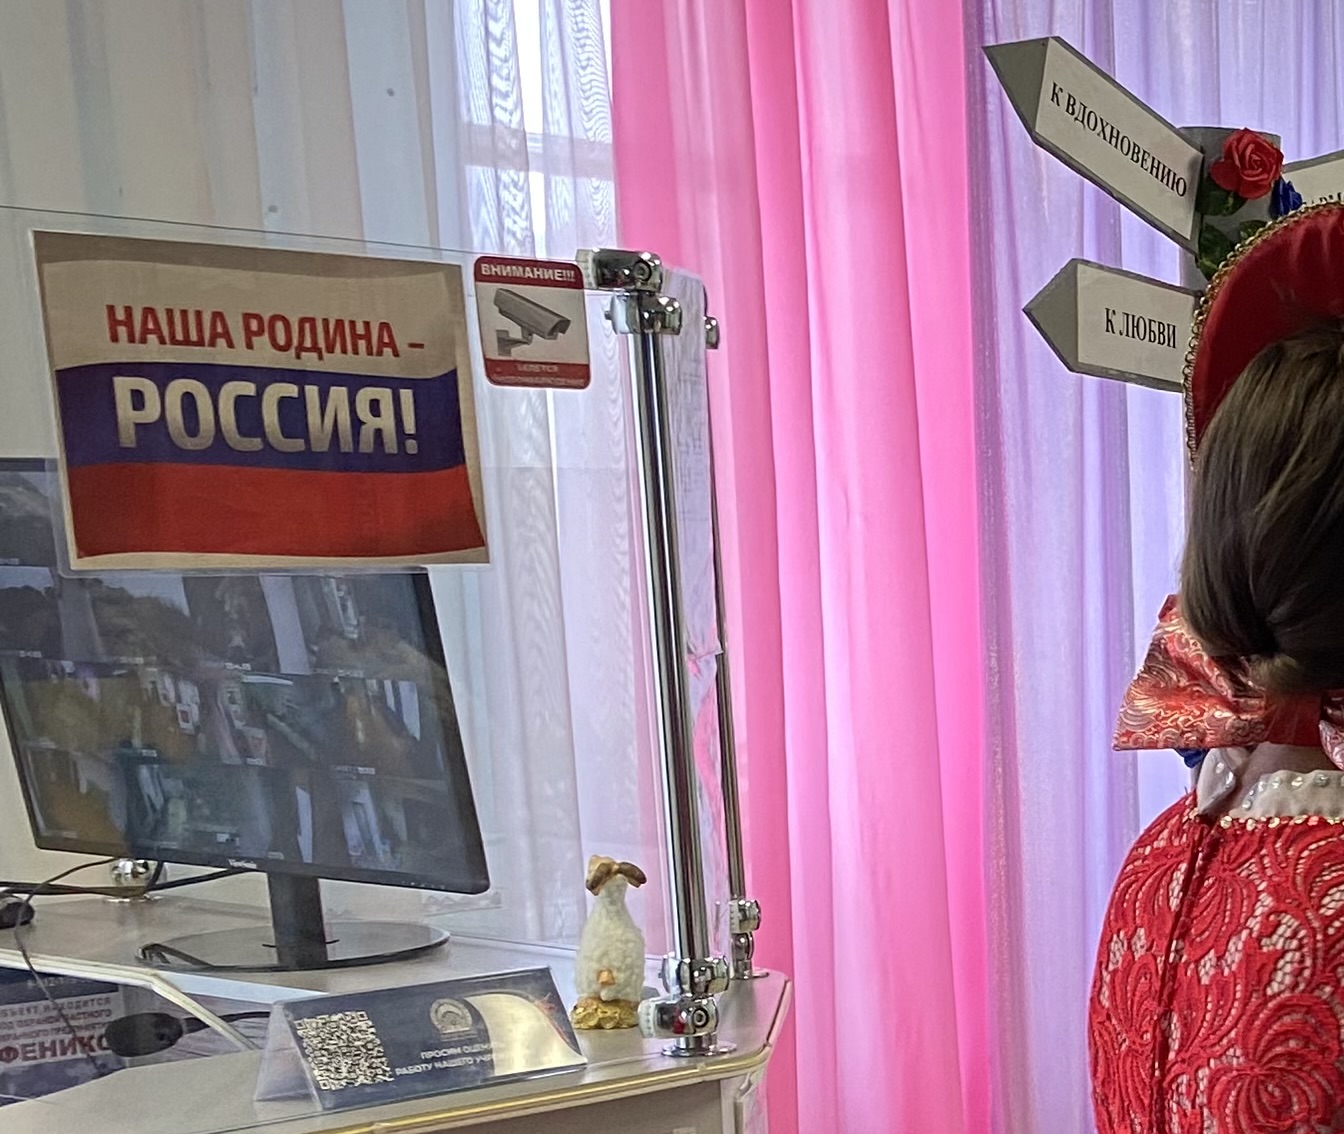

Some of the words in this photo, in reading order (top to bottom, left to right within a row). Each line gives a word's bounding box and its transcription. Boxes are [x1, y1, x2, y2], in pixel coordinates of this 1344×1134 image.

[1050, 81, 1064, 107] К
[1065, 92, 1187, 197] ВДОХНОВЕНИЮ
[481, 263, 576, 282] ВНИМАНИЕ!!!
[105, 304, 236, 350] НАША
[241, 311, 401, 361] РОДИНА
[1104, 307, 1117, 335] К
[1119, 311, 1177, 349] ЛЮБВИ
[112, 375, 419, 456] РОССИЯ!
[395, 1063, 432, 1076] РАБОТУ
[420, 1047, 461, 1059] ПРОСИМ
